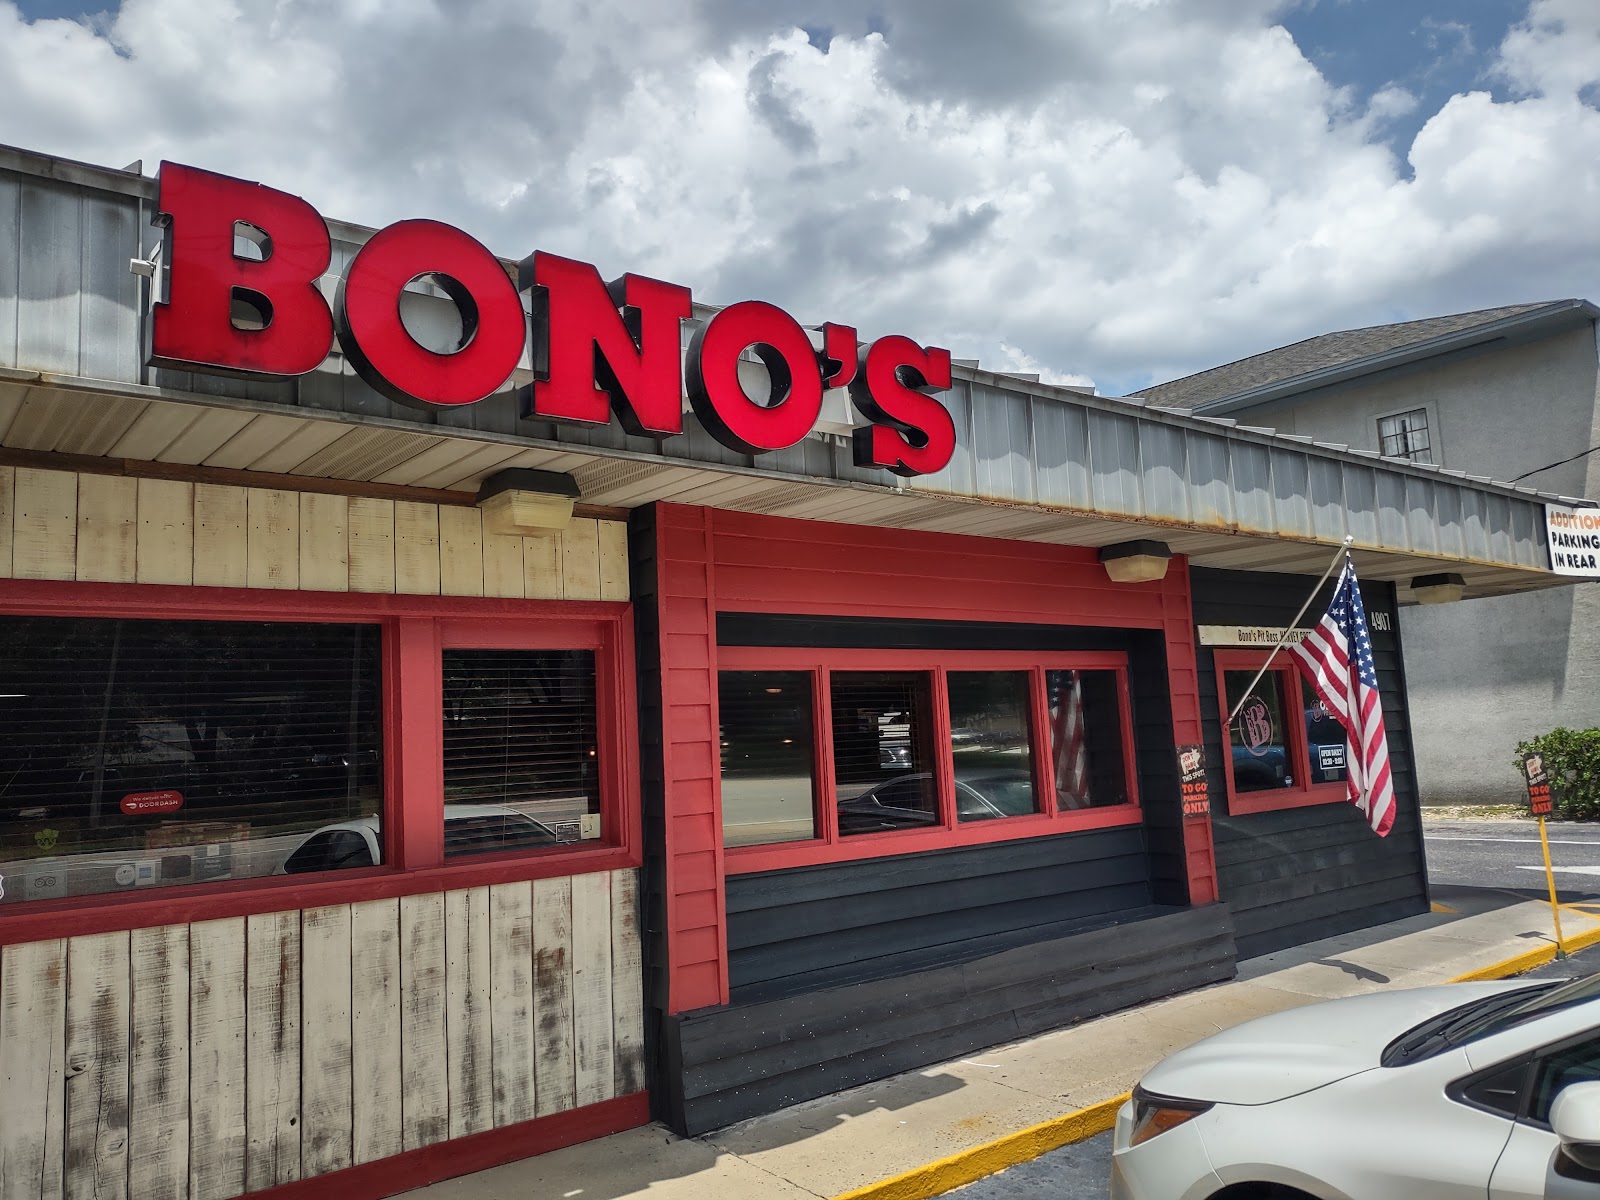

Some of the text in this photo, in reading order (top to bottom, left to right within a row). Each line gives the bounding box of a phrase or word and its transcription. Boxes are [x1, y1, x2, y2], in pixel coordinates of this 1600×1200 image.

[150, 159, 956, 477] BONO'S
[1552, 532, 1600, 549] PARKING
[1555, 552, 1597, 569] IN REAR
[1371, 611, 1391, 631] 4907
[1182, 773, 1192, 782] THIS
[1182, 783, 1207, 793] TO GO
[1529, 785, 1549, 795] TO GO
[139, 800, 178, 808] DOORDASH
[1183, 793, 1208, 802] PARKING
[1183, 801, 1209, 814] ONLY
[1532, 801, 1552, 814] ONLY
